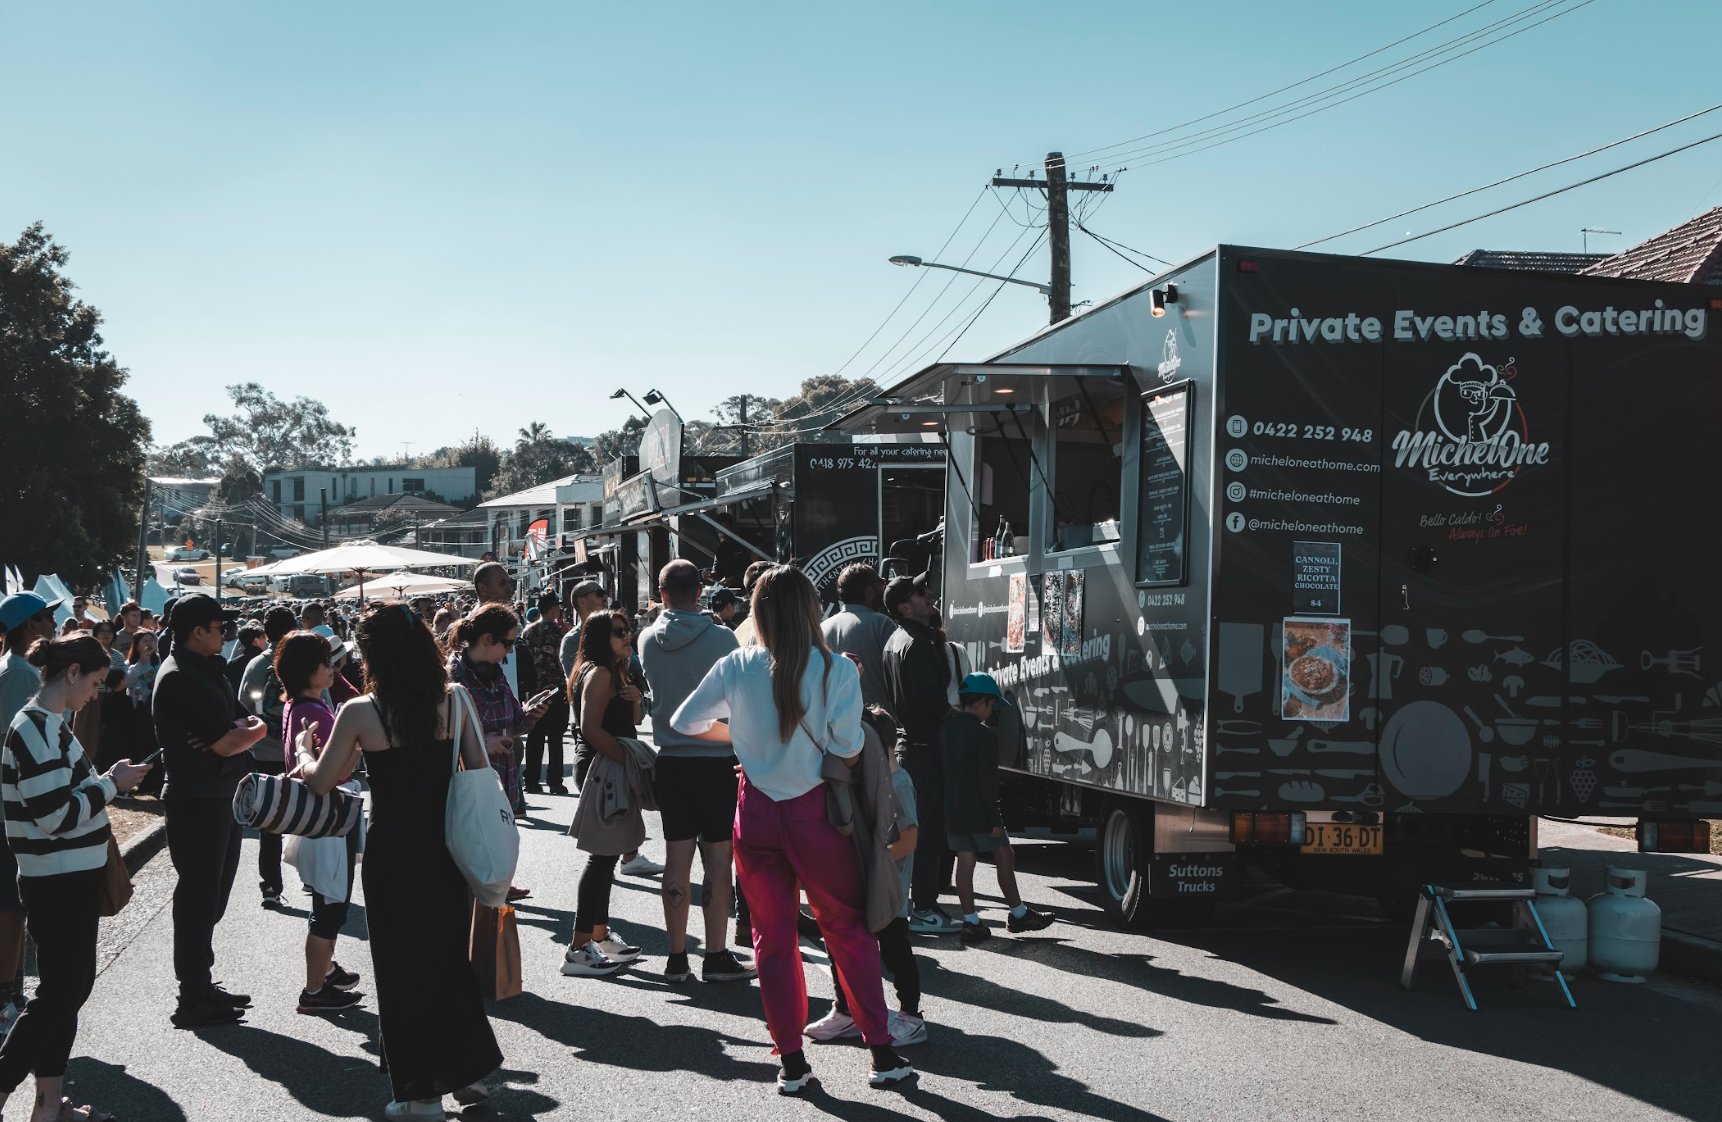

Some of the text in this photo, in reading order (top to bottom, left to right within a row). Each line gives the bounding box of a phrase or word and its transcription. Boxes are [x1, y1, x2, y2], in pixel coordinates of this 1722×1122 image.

[1250, 299, 1707, 344] Private Events & Catering
[1253, 421, 1373, 443] 0422 252 948
[853, 446, 867, 456] For
[870, 446, 879, 456] all
[881, 449, 899, 458] your
[901, 446, 932, 459] catering
[1391, 430, 1550, 468] MichelOne
[837, 458, 854, 469] 975
[1250, 454, 1381, 473] micheloneathome.com
[1429, 466, 1516, 487] Everywhere
[1249, 488, 1361, 505] #micheloneathome
[1248, 518, 1364, 534] @micheloneathome
[1419, 512, 1482, 527] Bello Caldo!
[1449, 528, 1485, 544] Always
[1302, 565, 1331, 573] ZESTY
[1297, 574, 1336, 583] RICOTTA
[1020, 654, 1050, 680] Events
[1169, 864, 1223, 878] Suttons
[1178, 881, 1216, 893] Trucks
